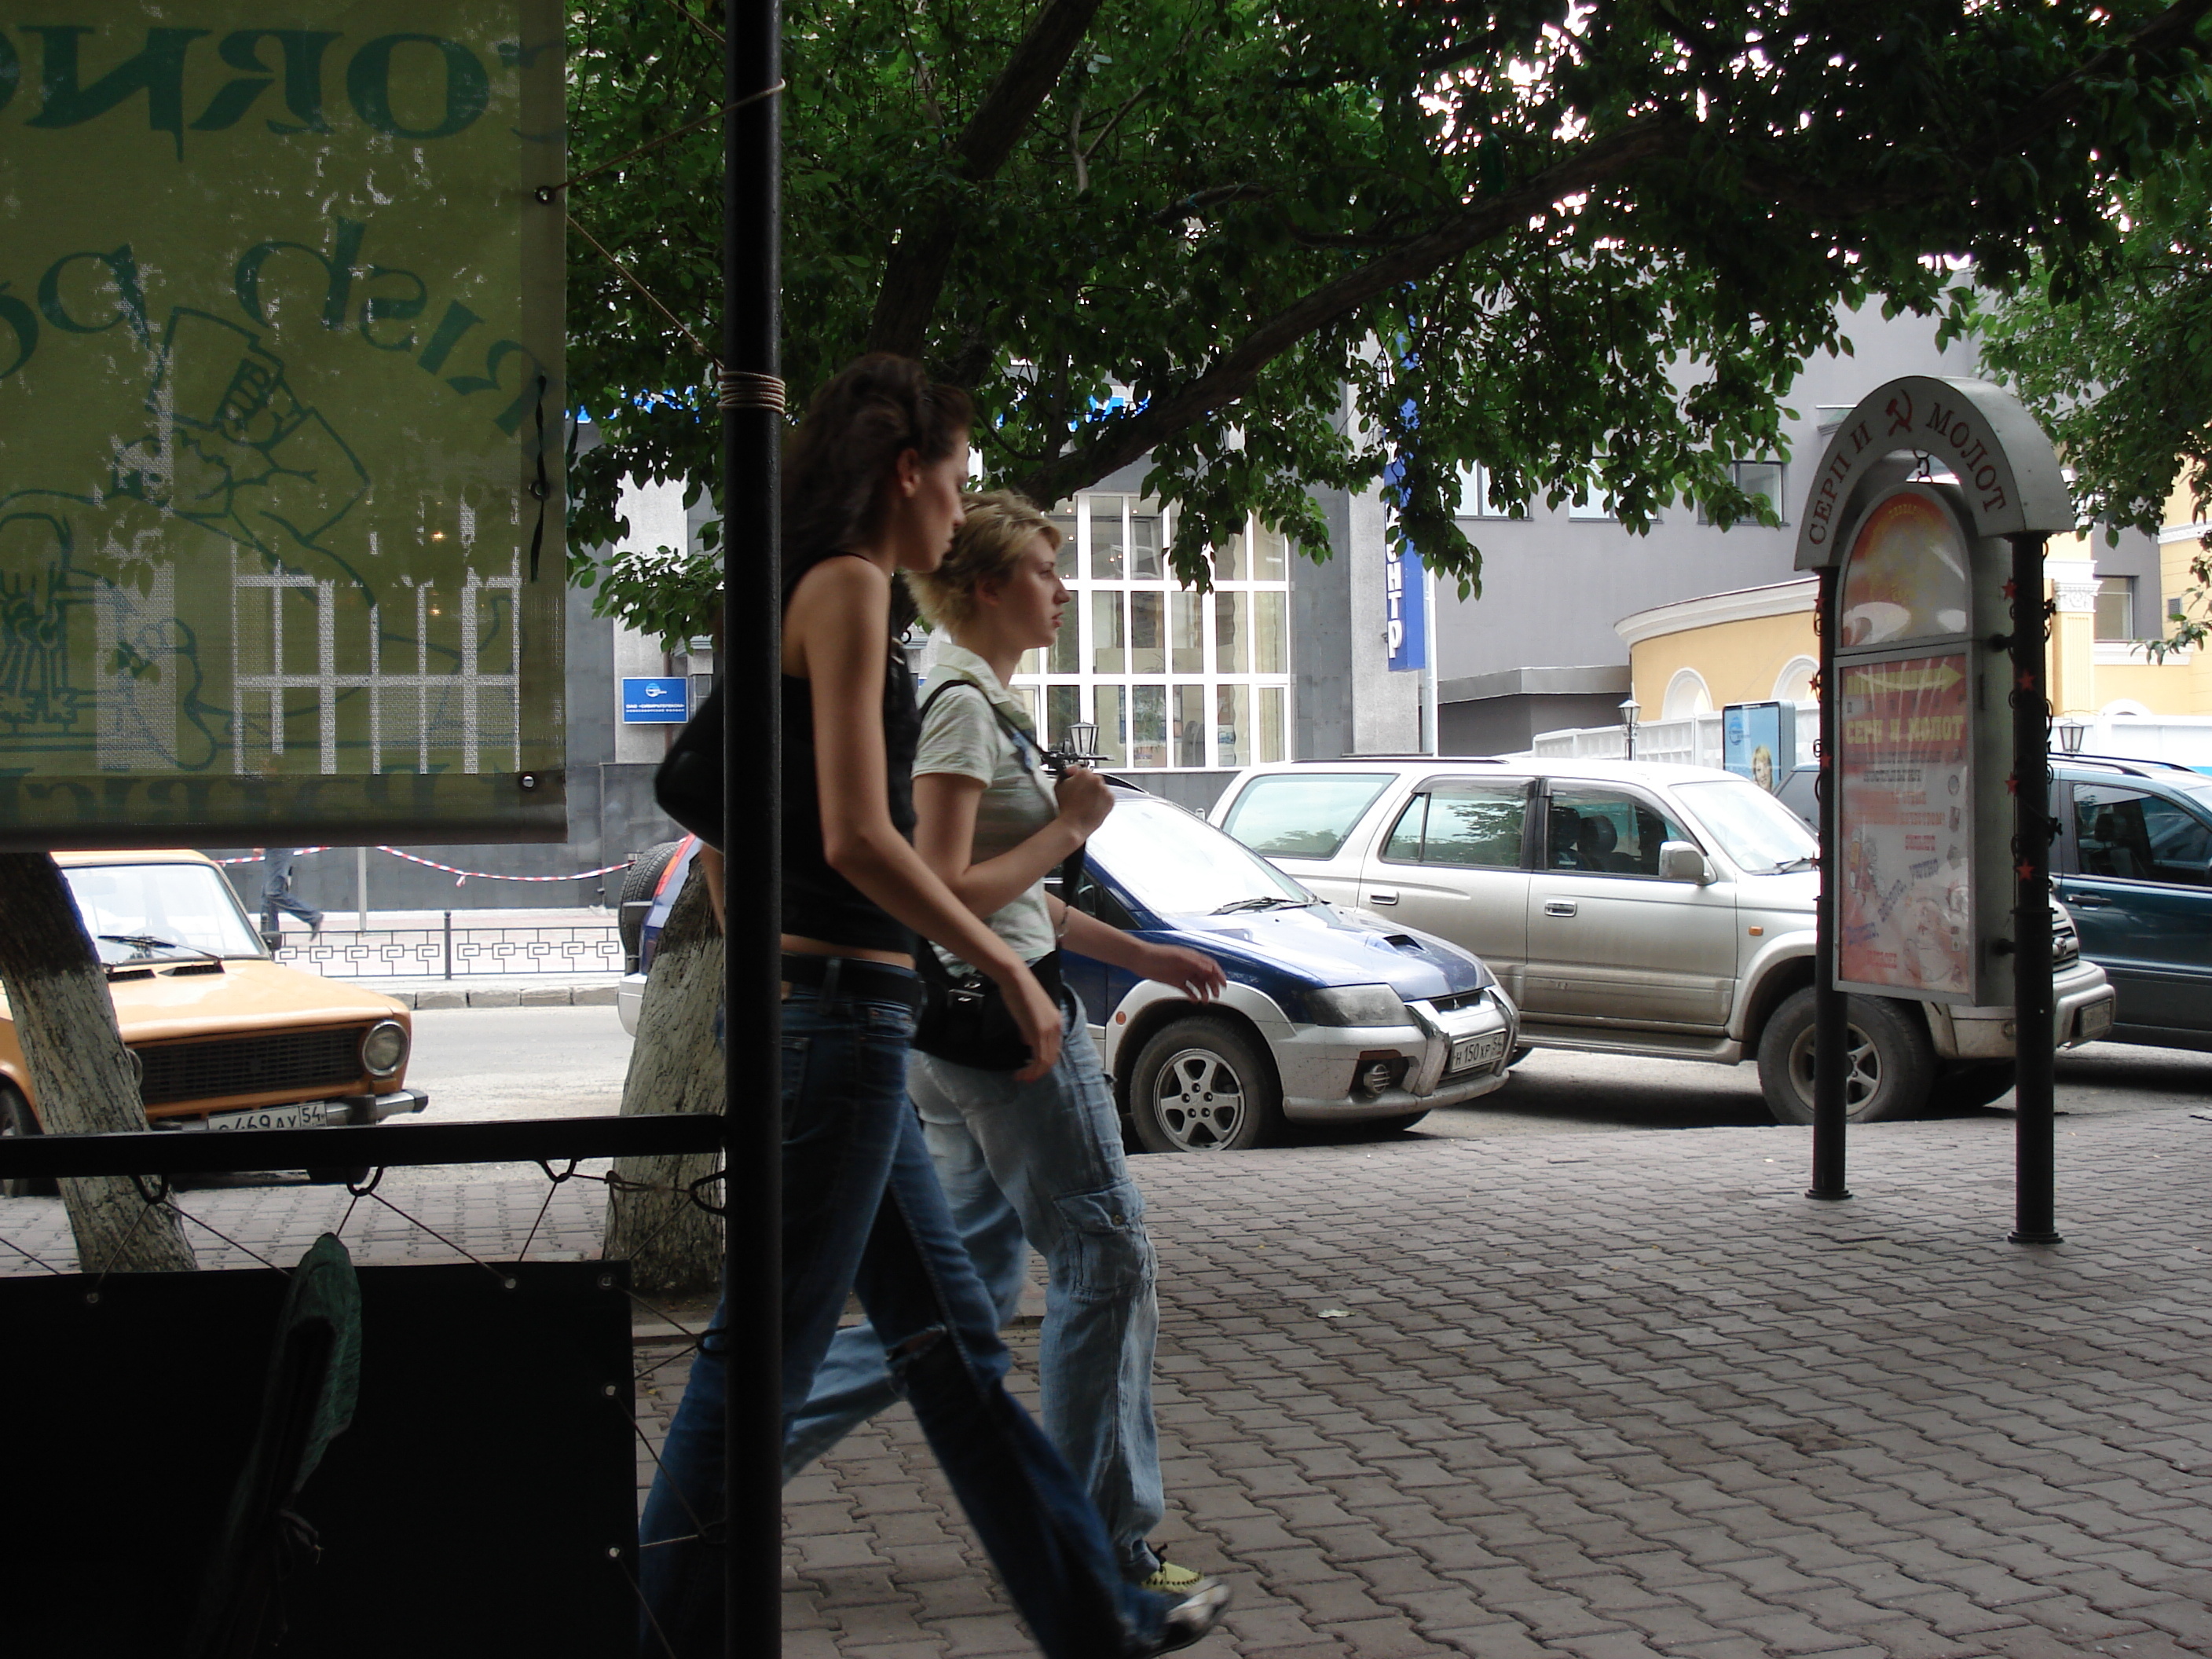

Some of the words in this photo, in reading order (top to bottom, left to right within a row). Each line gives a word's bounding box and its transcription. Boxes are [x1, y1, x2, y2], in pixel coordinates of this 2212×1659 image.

[1808, 452, 1852, 545] СЕРП
[1850, 419, 1873, 455] И
[1925, 401, 2007, 512] МОЛОТ
